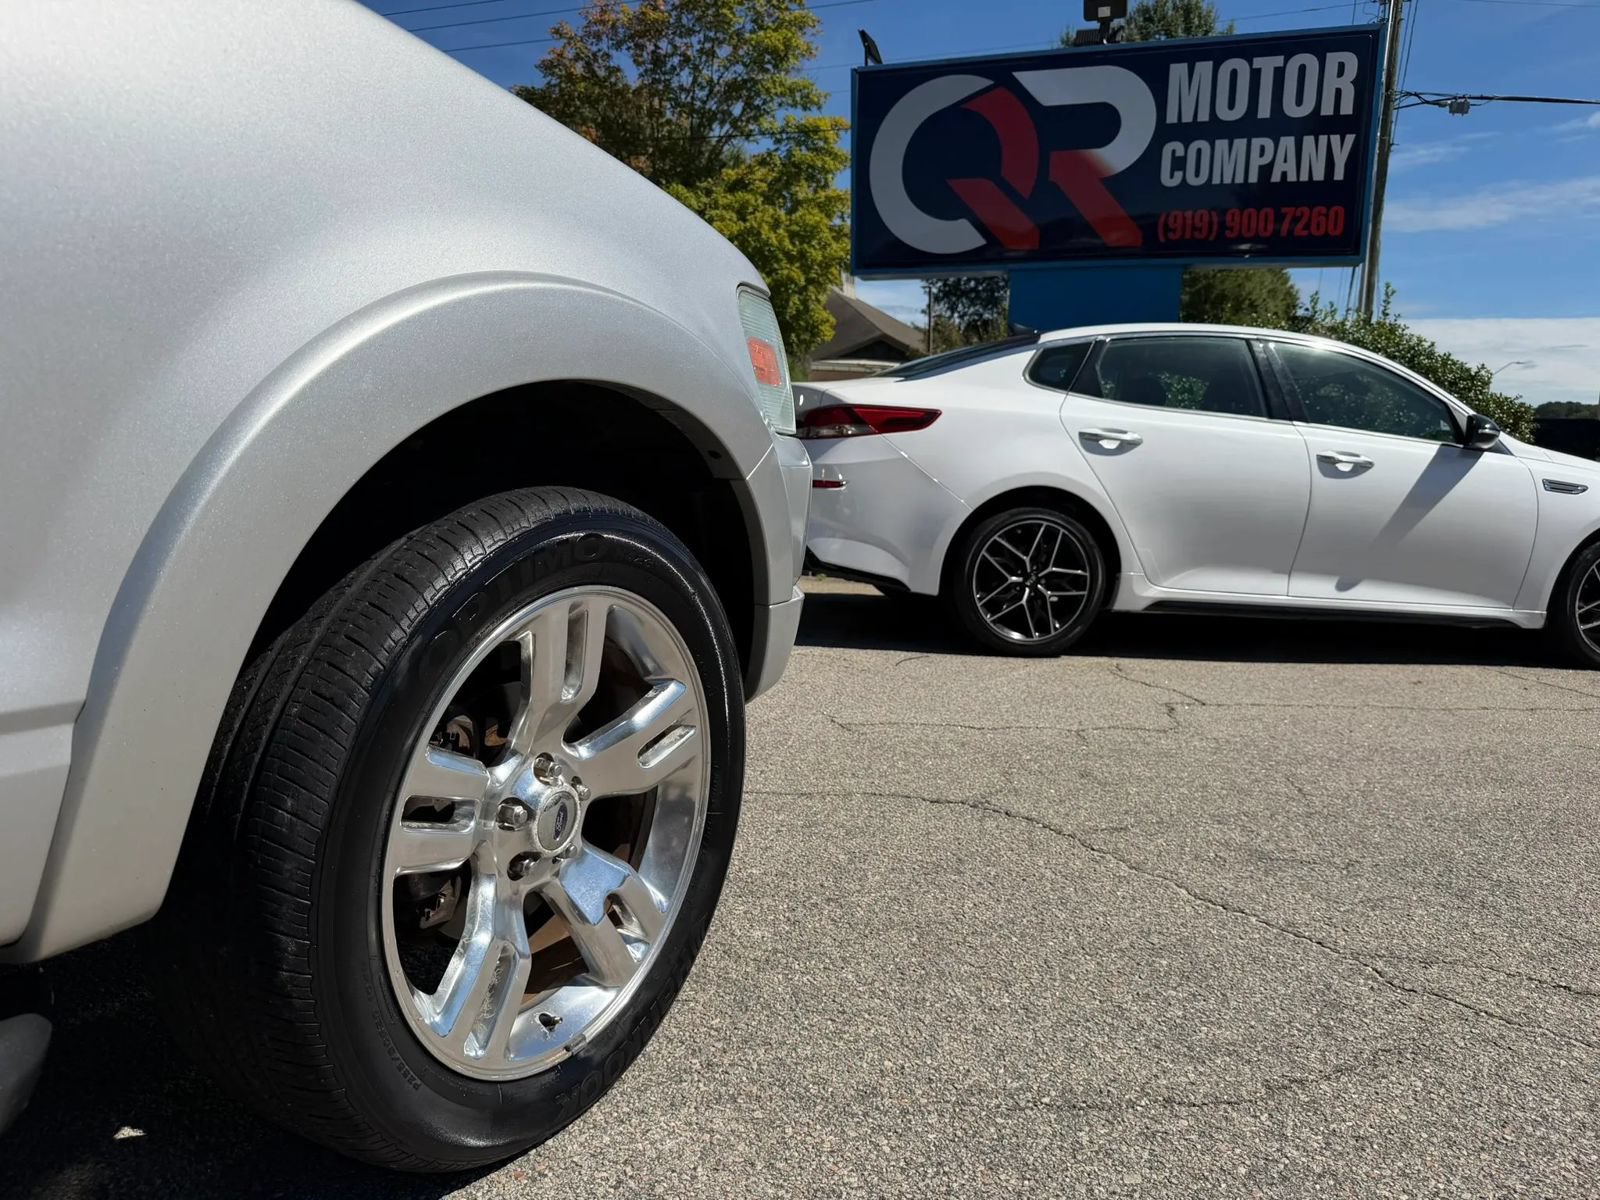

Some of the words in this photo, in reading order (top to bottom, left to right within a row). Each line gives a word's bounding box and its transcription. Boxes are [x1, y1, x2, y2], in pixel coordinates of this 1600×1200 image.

[1165, 51, 1359, 124] MOTOR
[869, 65, 1157, 254] QR
[1159, 134, 1356, 188] COMPANY
[1157, 208, 1219, 242] (919)
[1225, 207, 1275, 239] 900
[1279, 205, 1345, 237] 7260
